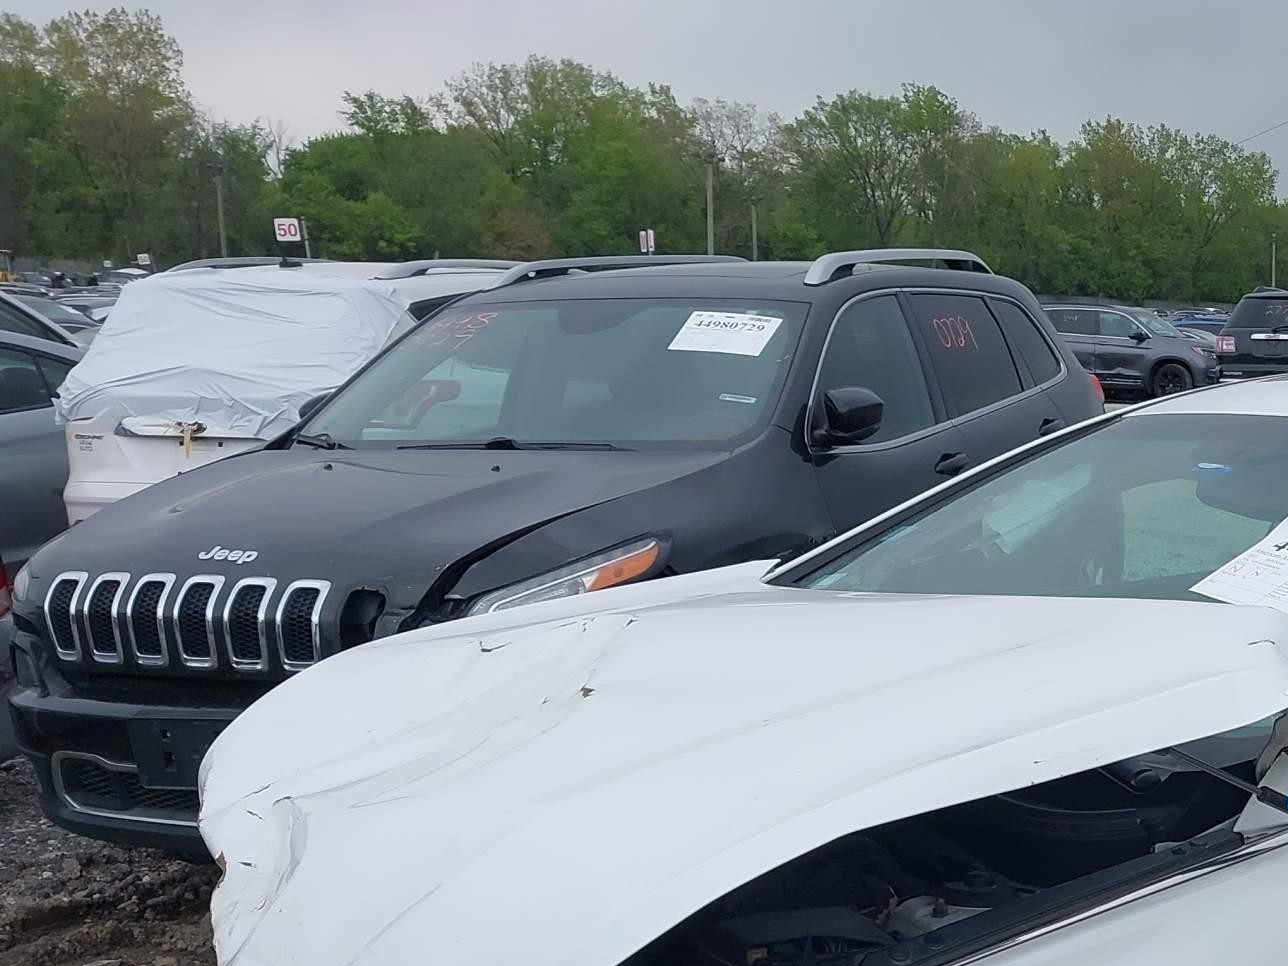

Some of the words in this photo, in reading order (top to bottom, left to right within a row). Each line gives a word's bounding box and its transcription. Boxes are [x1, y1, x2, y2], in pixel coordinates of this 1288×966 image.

[276, 223, 298, 237] 50
[693, 320, 766, 332] 44980729
[933, 315, 979, 350] 0729
[198, 545, 259, 565] Jeep
